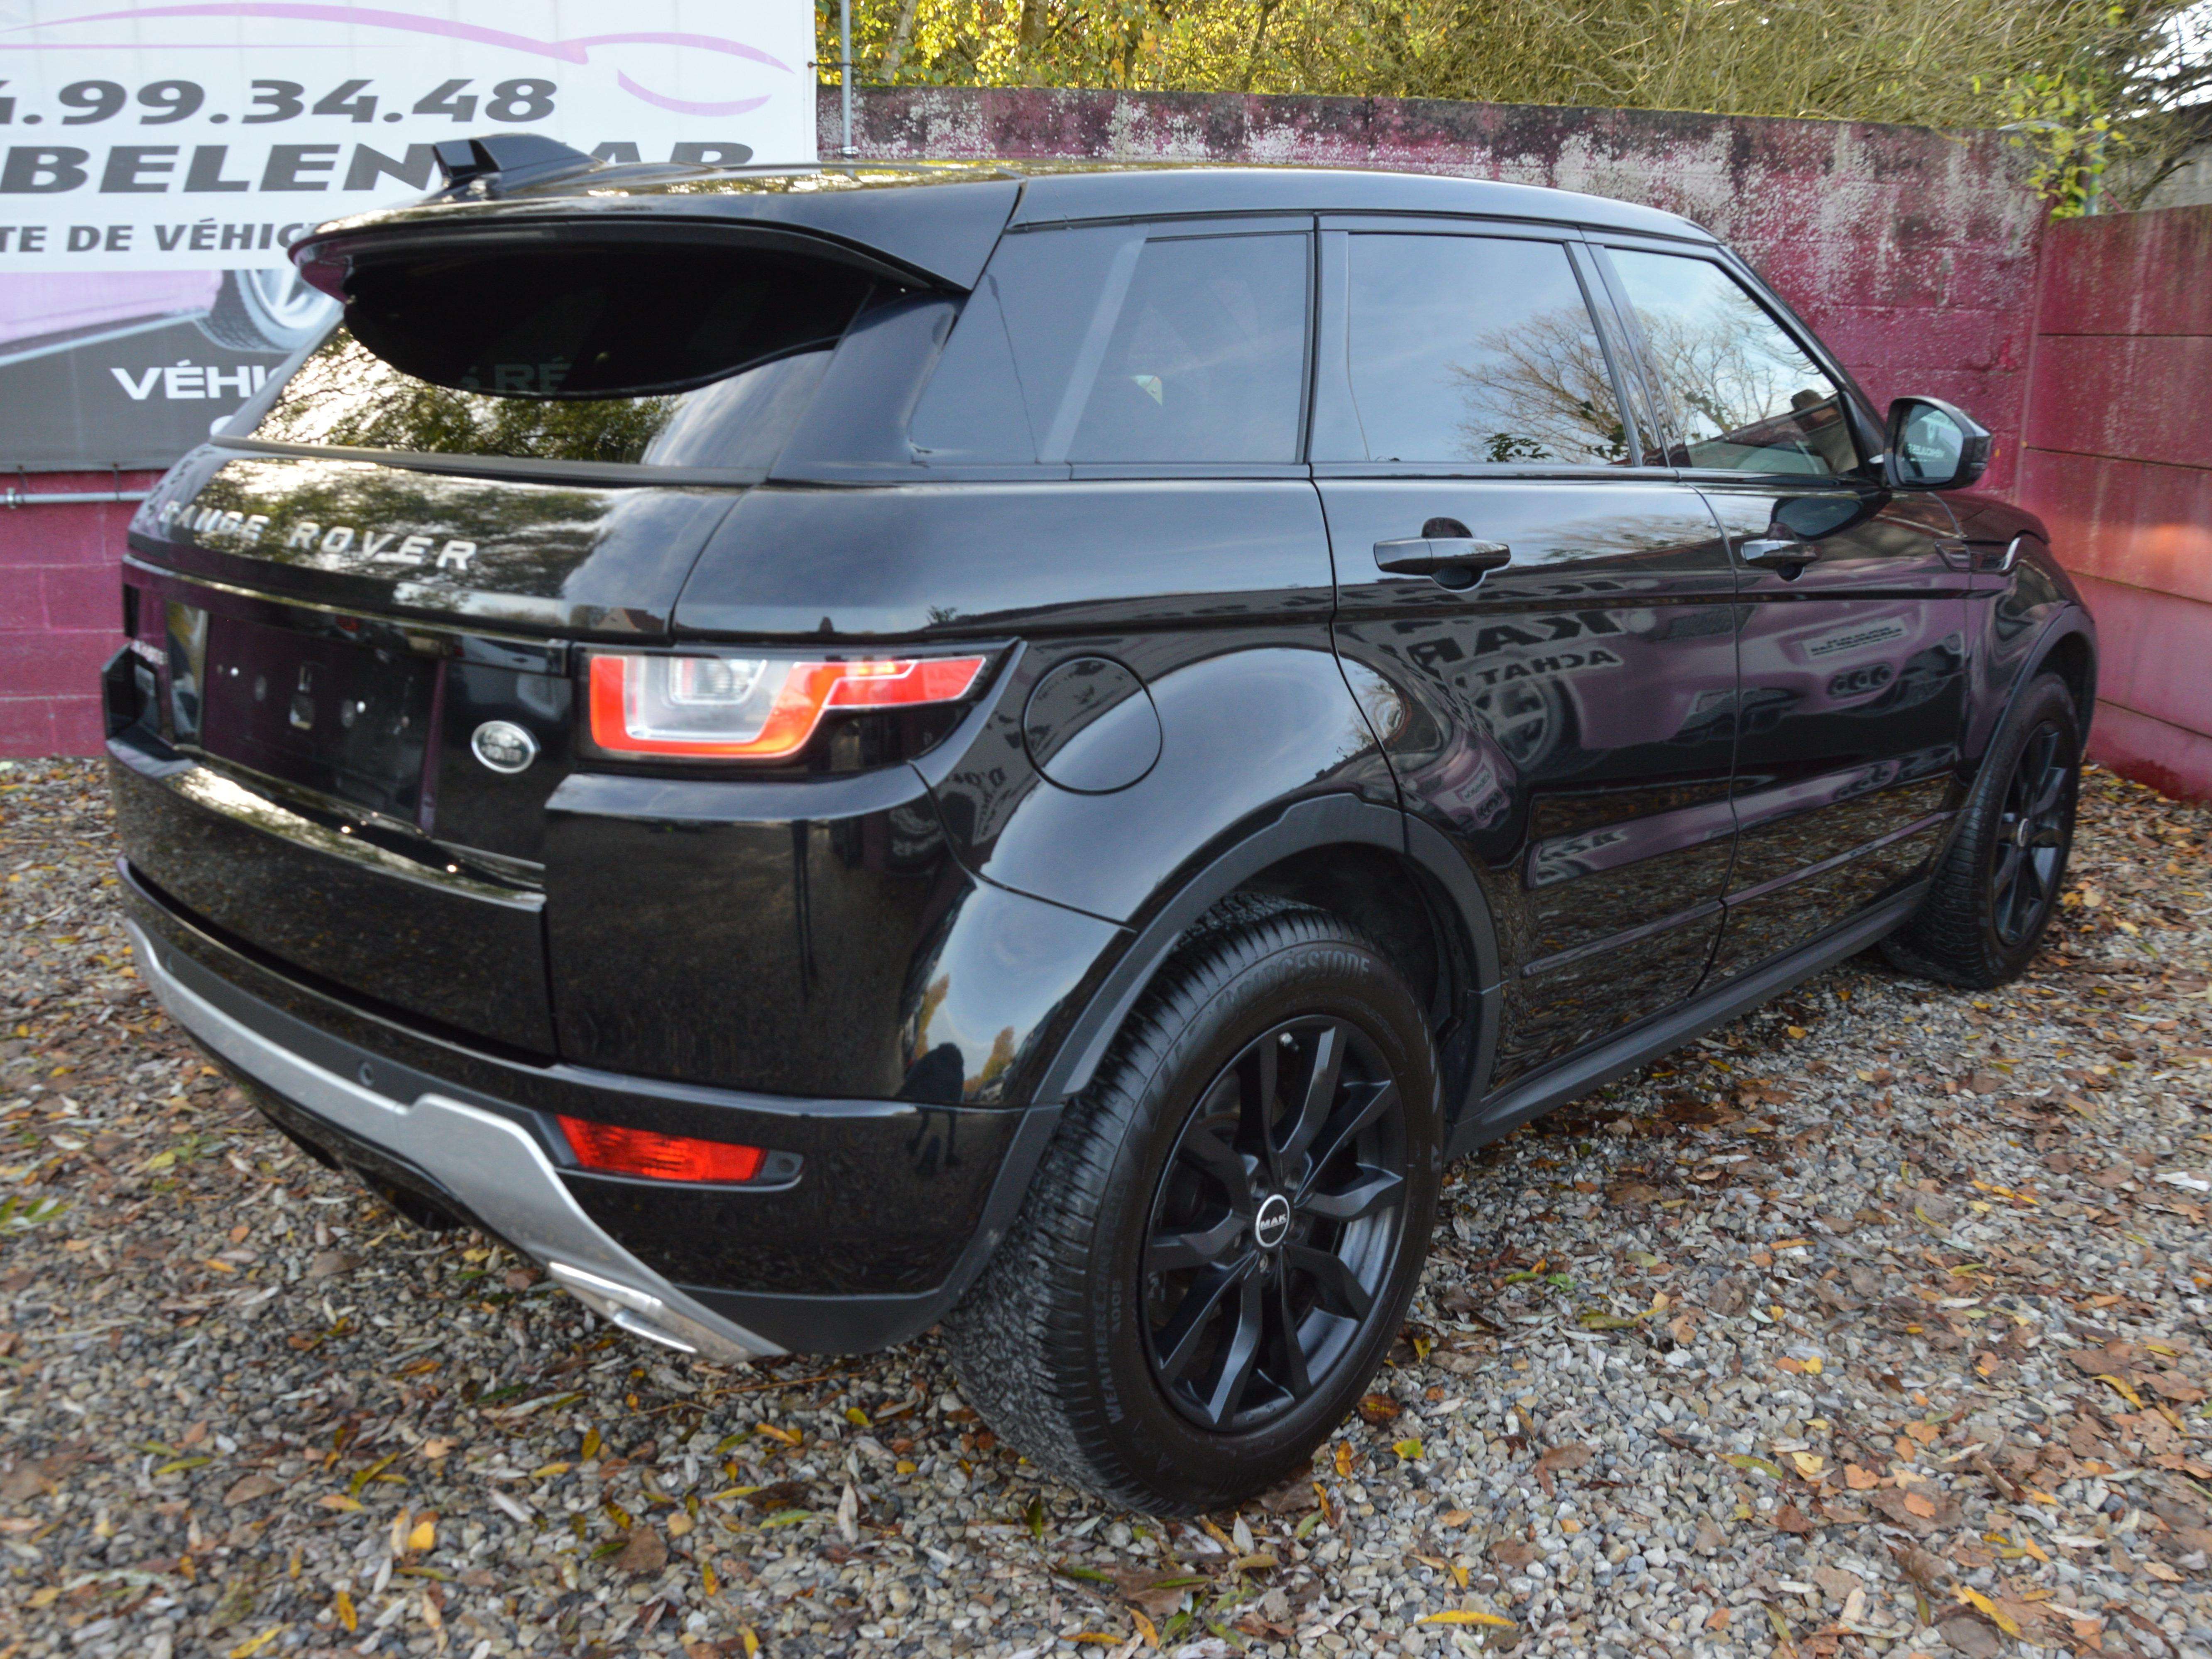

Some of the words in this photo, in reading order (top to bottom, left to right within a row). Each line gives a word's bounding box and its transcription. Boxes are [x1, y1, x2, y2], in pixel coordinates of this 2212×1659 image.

[0, 78, 557, 125] .99.34.48
[66, 225, 133, 252] DE
[154, 218, 316, 251] VÉHIC
[110, 360, 281, 399] VÉHI
[287, 521, 477, 570] ROVER
